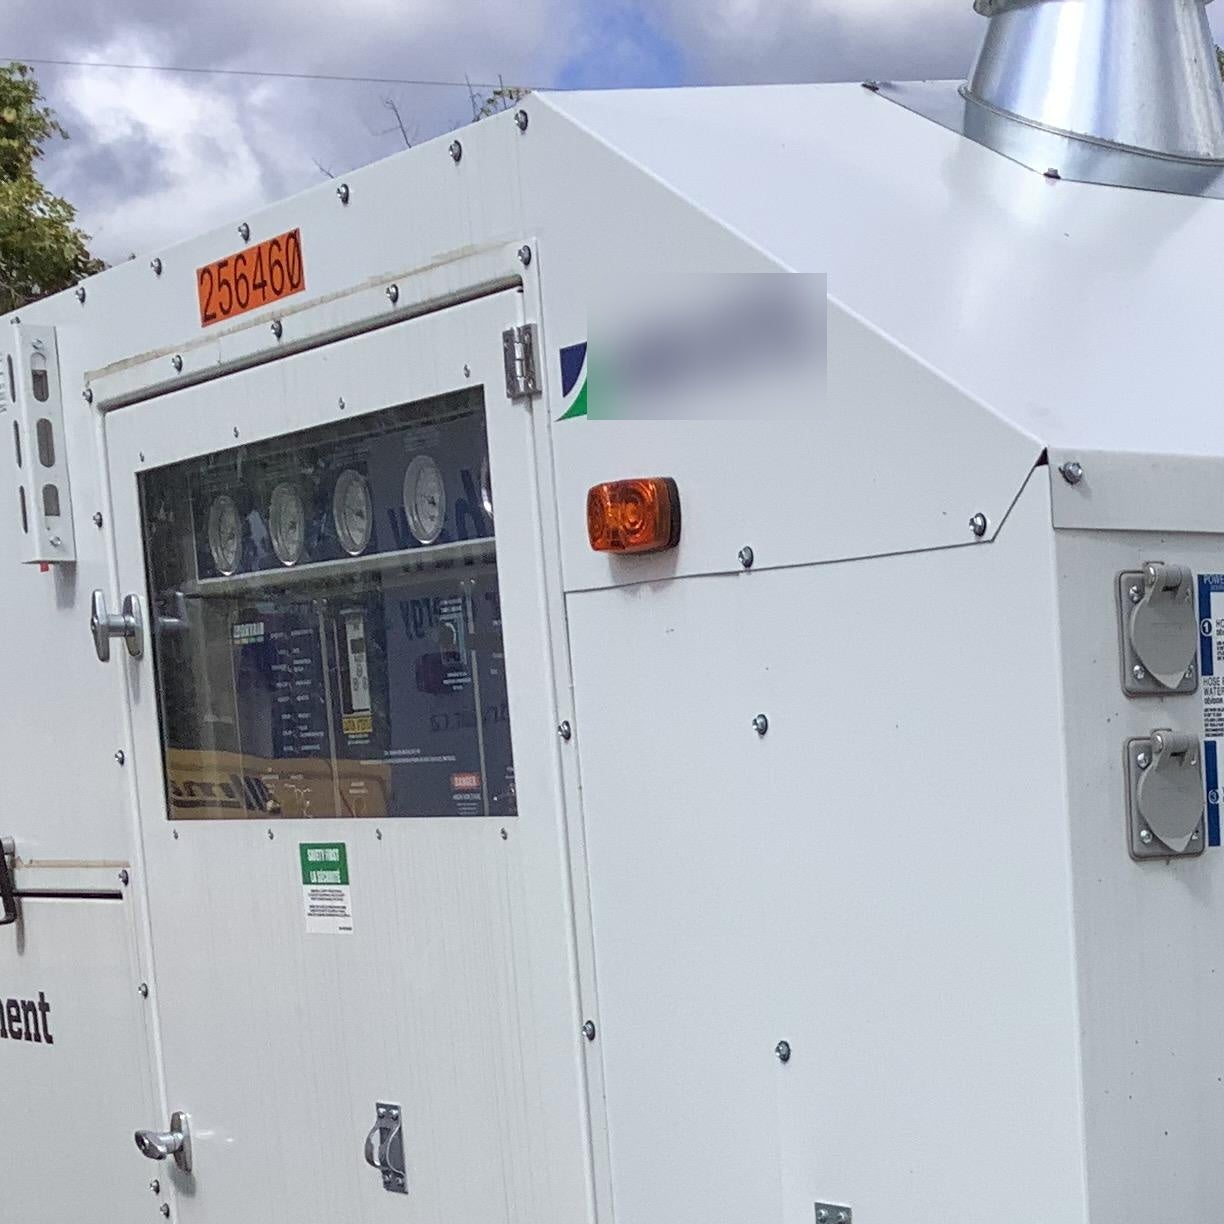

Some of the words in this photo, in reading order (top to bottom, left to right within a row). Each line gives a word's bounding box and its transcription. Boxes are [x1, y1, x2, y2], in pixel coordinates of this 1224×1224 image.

[200, 230, 301, 322] 256460
[1203, 677, 1220, 686] HOSE
[1204, 686, 1224, 696] WATER
